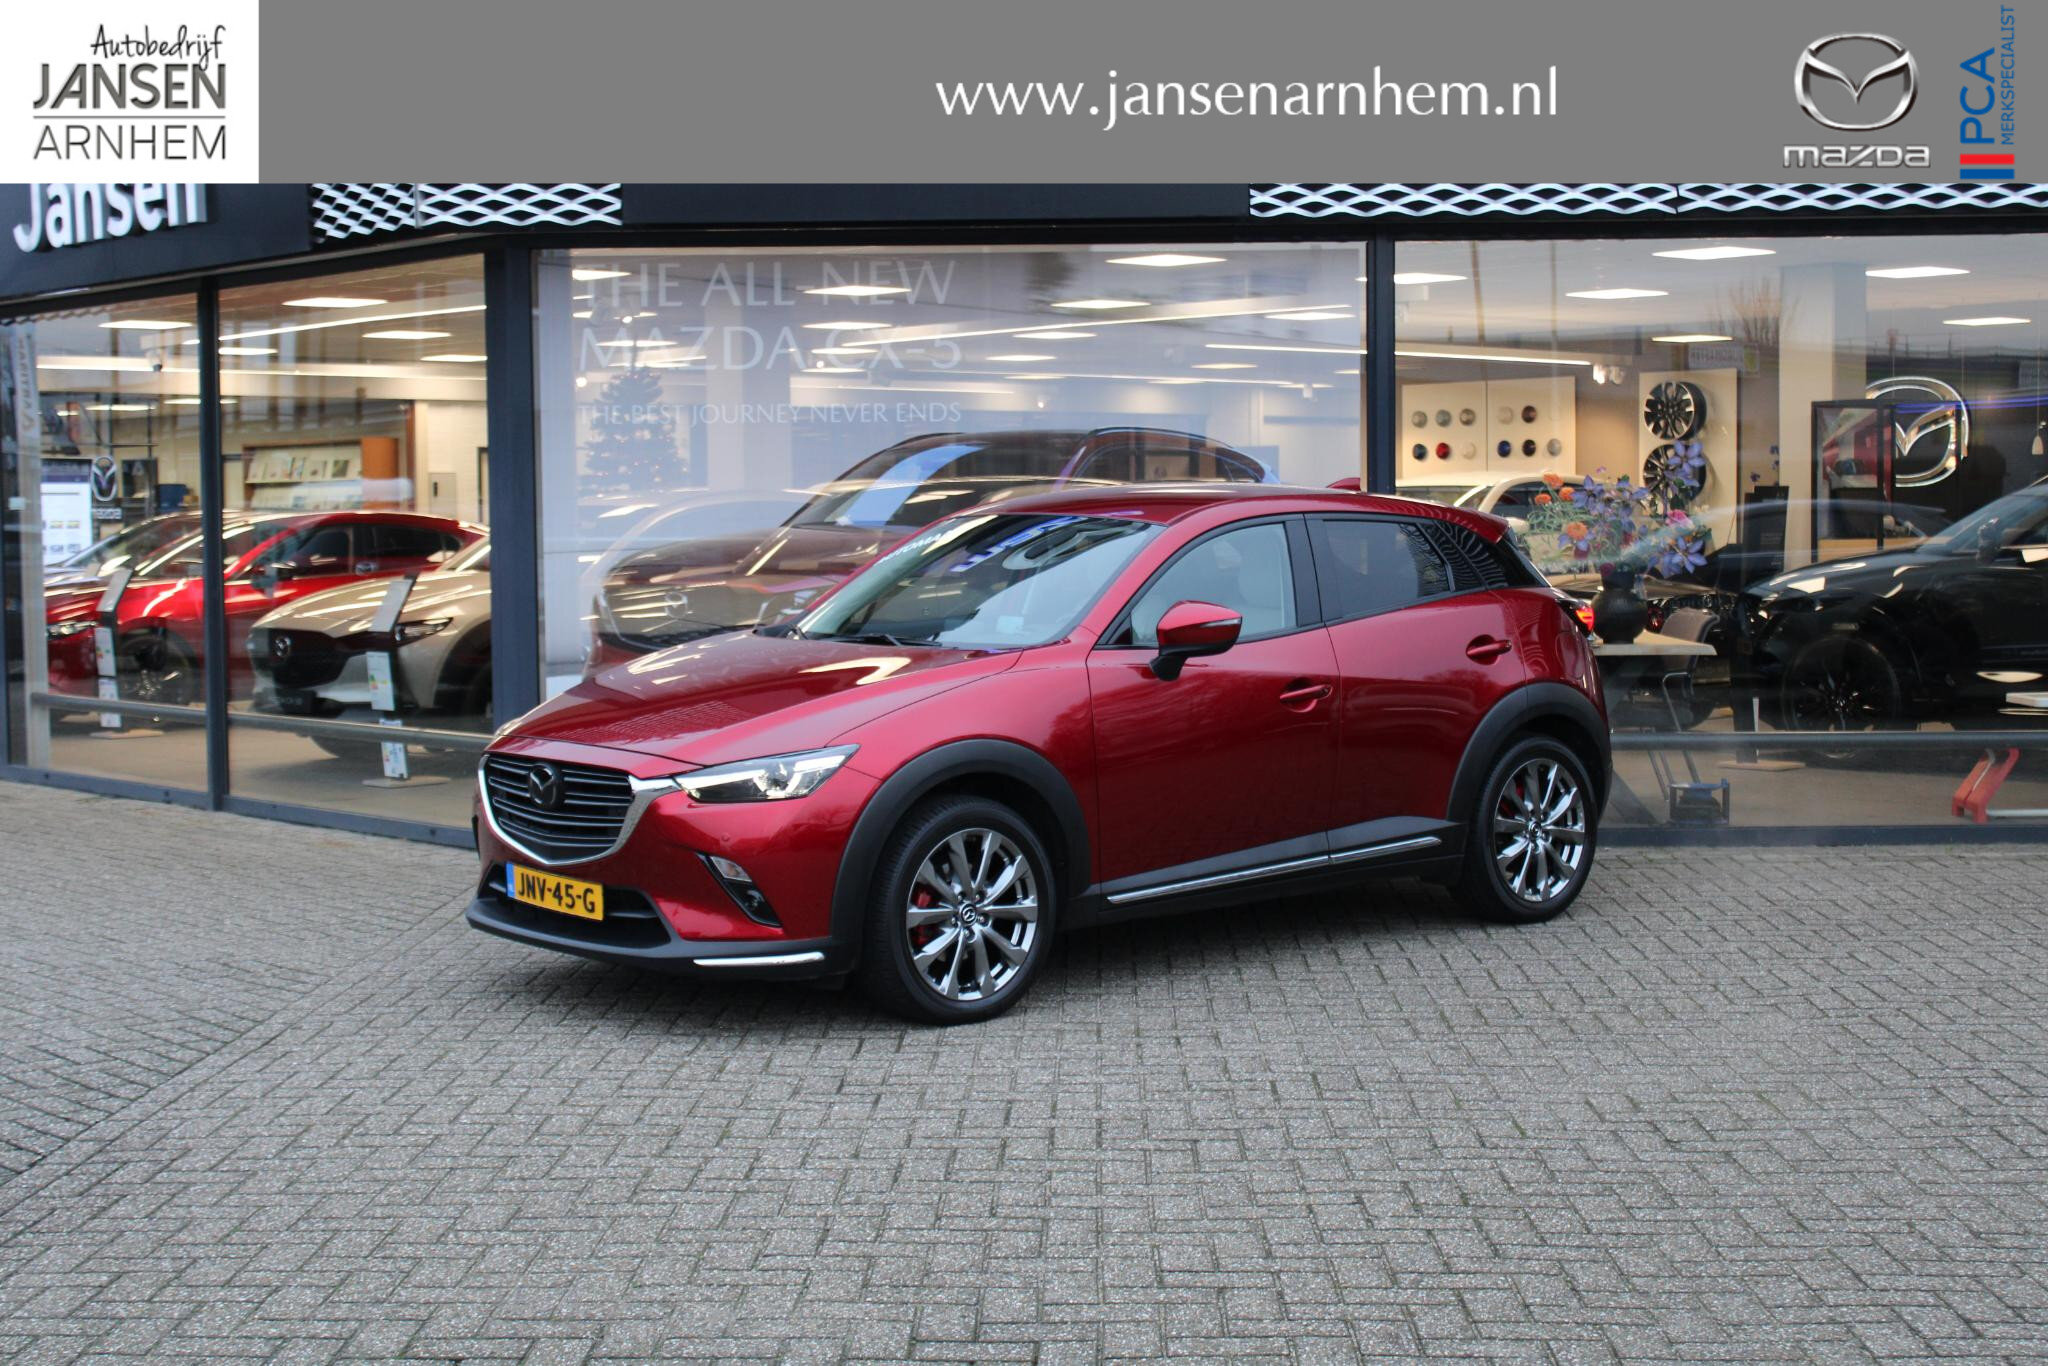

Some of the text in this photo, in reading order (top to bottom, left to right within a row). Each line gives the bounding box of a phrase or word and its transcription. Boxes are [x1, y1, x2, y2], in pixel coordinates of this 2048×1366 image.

[13, 183, 208, 253] Jansen
[573, 262, 684, 308] THE
[578, 322, 962, 372] MAZDA CX-5
[577, 401, 962, 427] THE BEST JOURNEY NEVER ENDS
[517, 872, 596, 914] JNV-45-G
